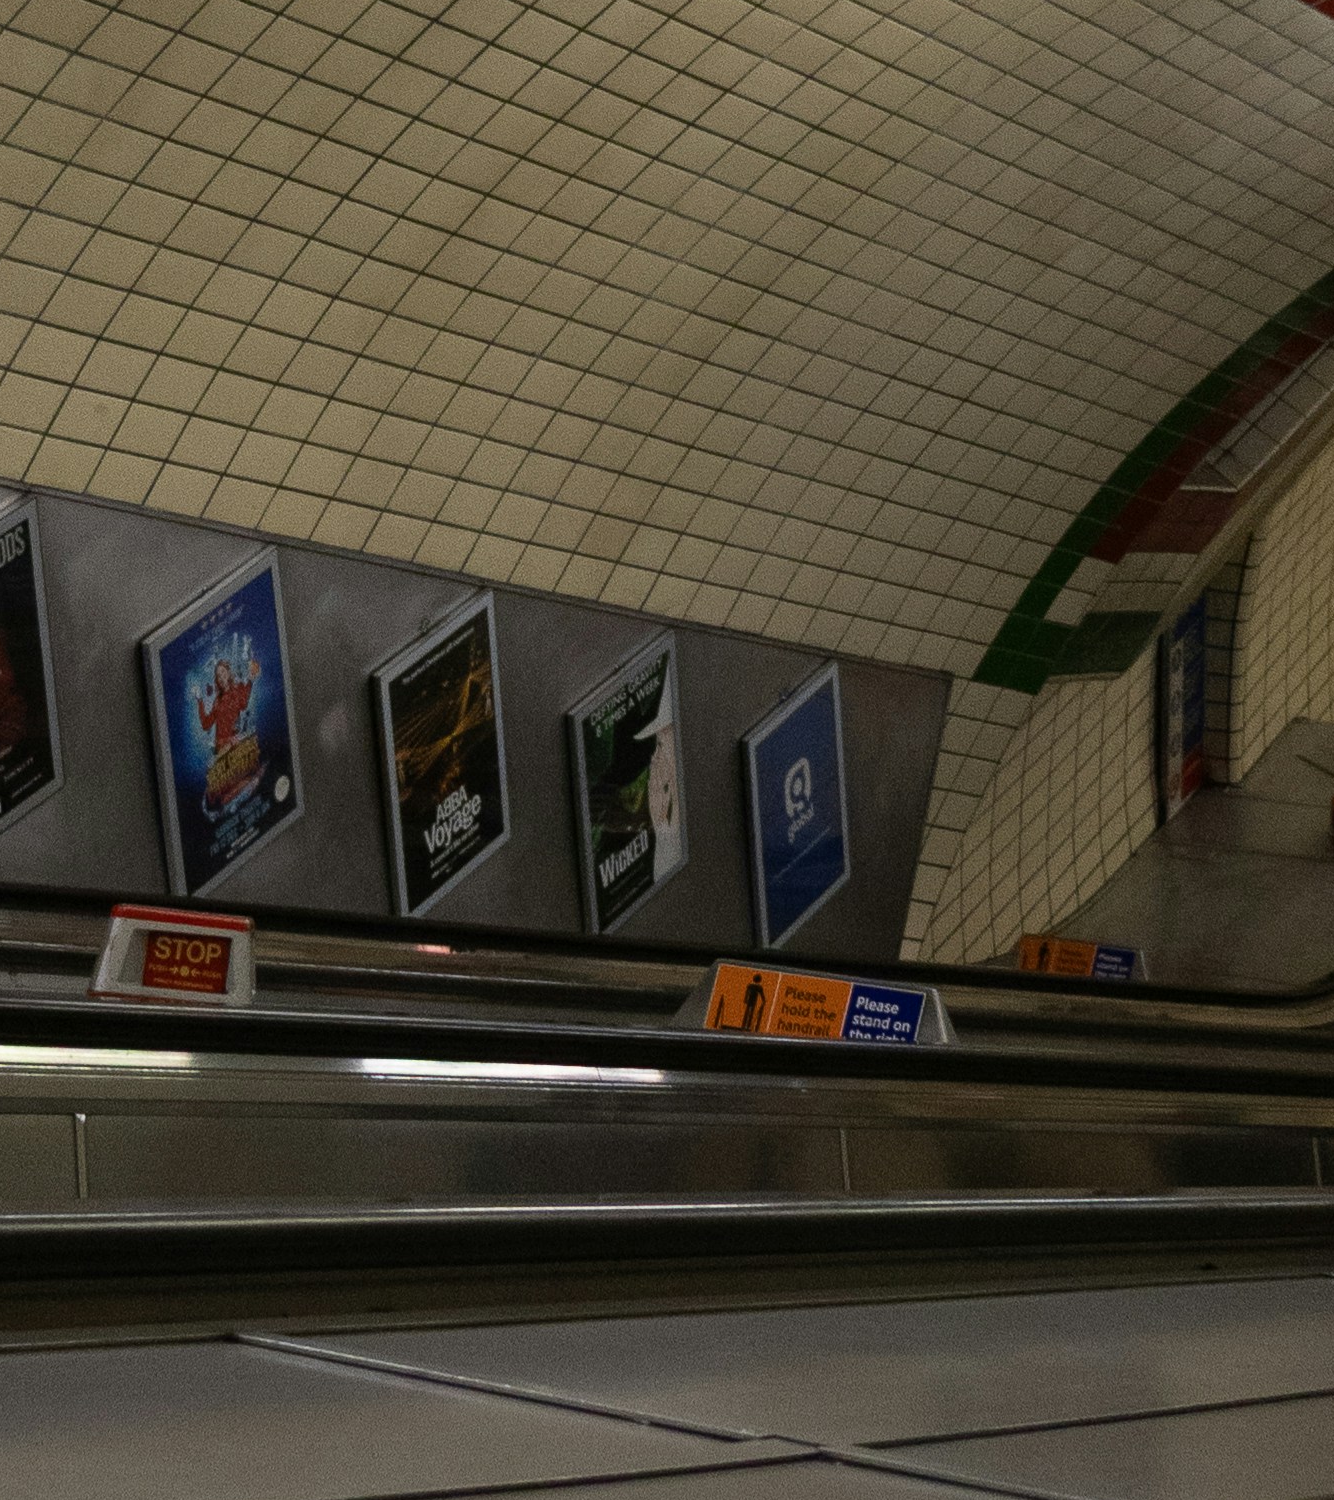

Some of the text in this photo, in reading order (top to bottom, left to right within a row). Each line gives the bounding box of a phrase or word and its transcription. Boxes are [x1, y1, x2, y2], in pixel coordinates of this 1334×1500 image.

[436, 784, 468, 825] ABBA
[423, 794, 482, 854] Voyage
[155, 935, 222, 965] STOP
[785, 985, 827, 1004] Please
[781, 1003, 837, 1022] hold the
[855, 995, 899, 1015] Please
[777, 1020, 831, 1038] handrail
[851, 1013, 911, 1034] stand on
